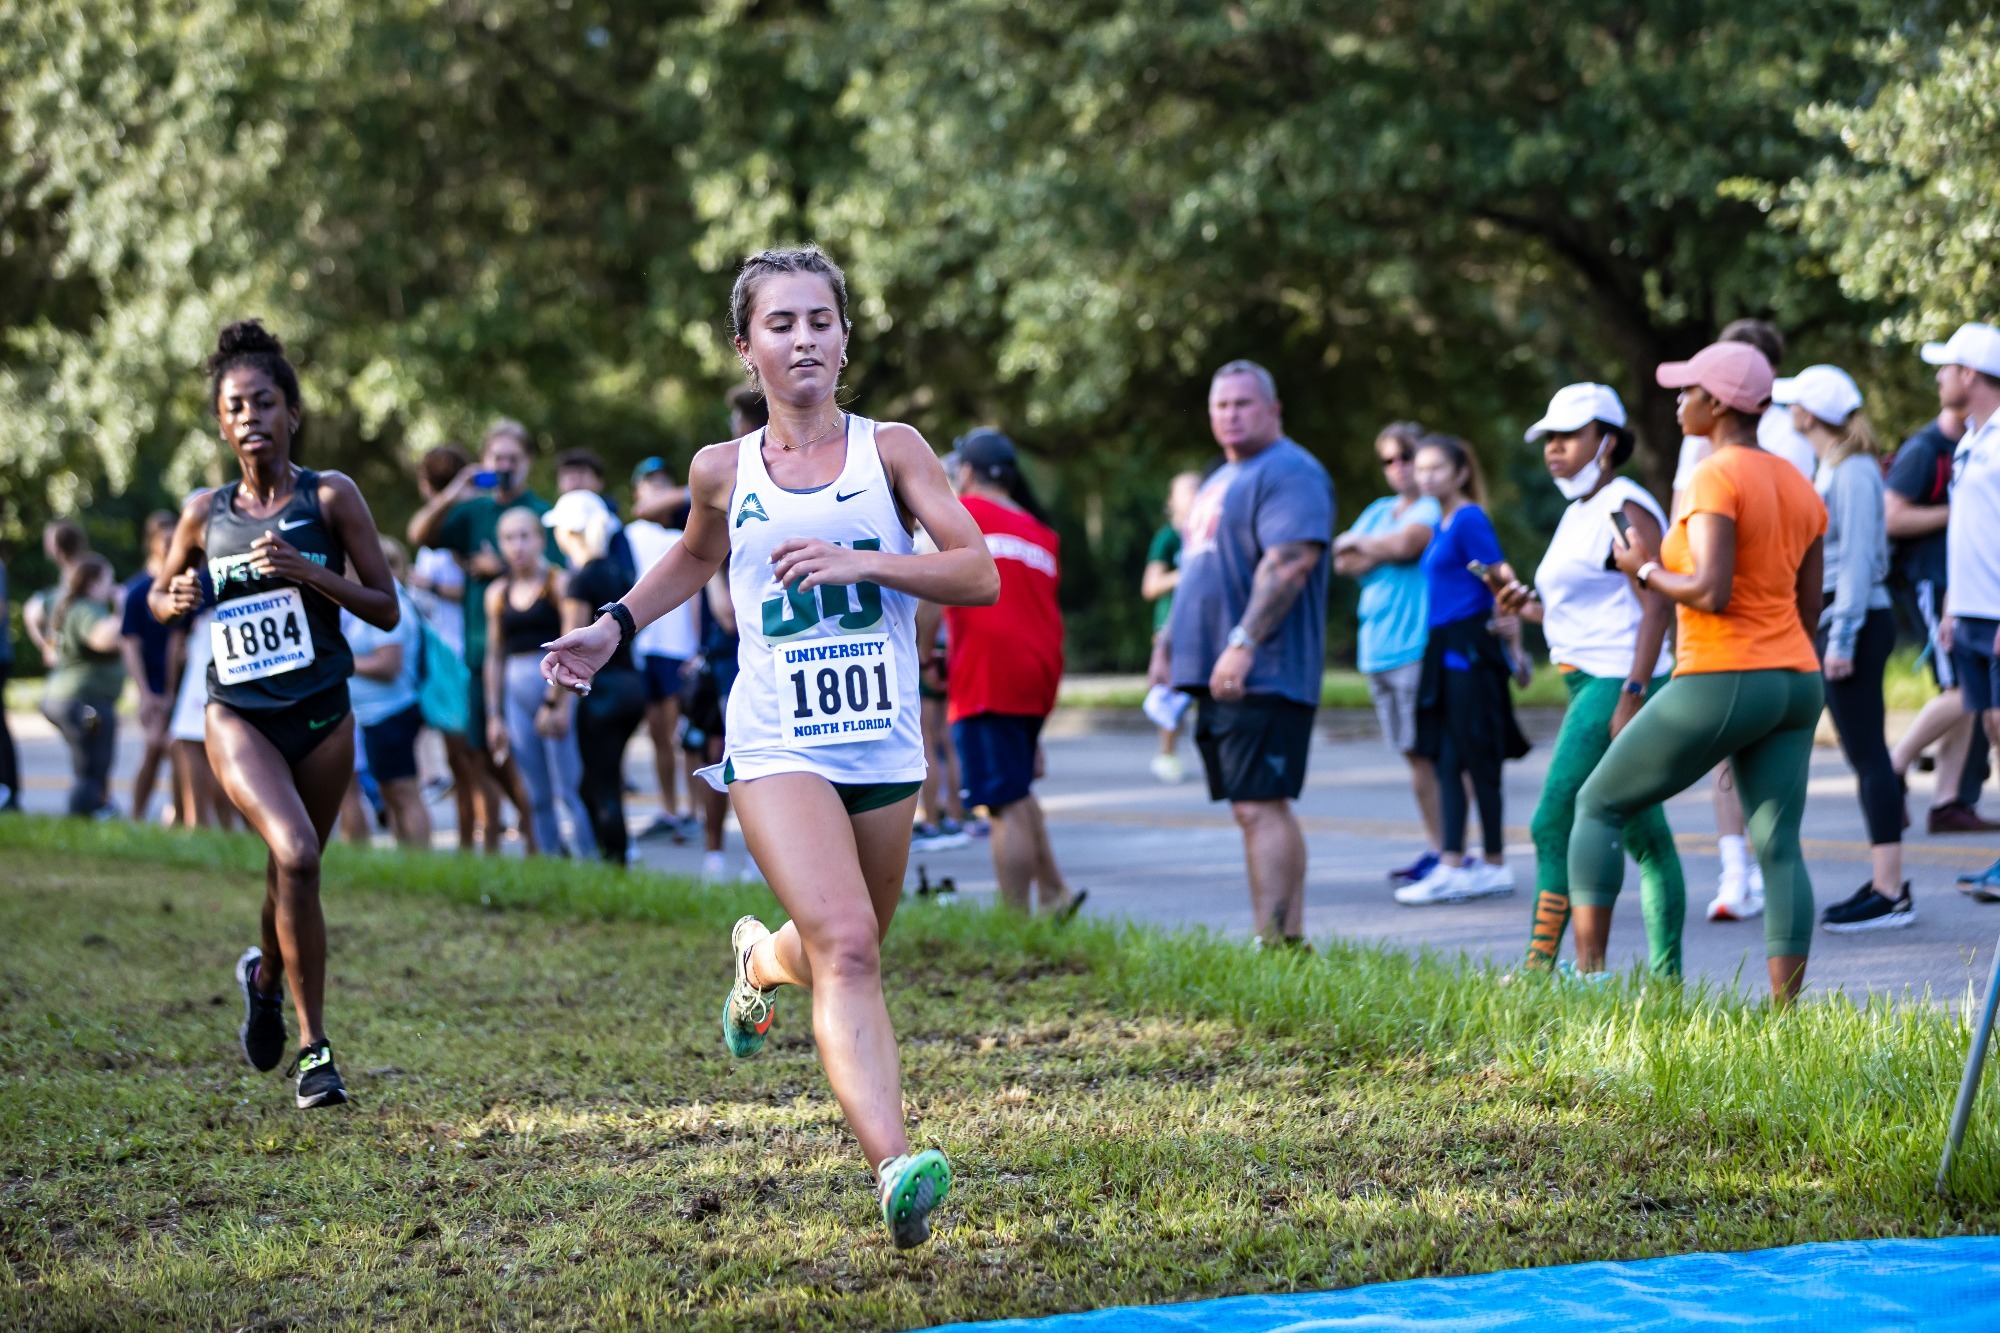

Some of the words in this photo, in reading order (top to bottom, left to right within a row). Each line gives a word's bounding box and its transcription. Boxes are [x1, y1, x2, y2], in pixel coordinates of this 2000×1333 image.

[216, 594, 292, 621] UNIVERSITY
[222, 611, 301, 660] 1884
[228, 660, 261, 675] NORTH
[263, 651, 305, 668] FLORIDA
[785, 642, 884, 663] UNIVERSITY
[790, 662, 892, 718] 1801
[794, 722, 840, 737] NORTH
[843, 718, 892, 732] FLORIDA
